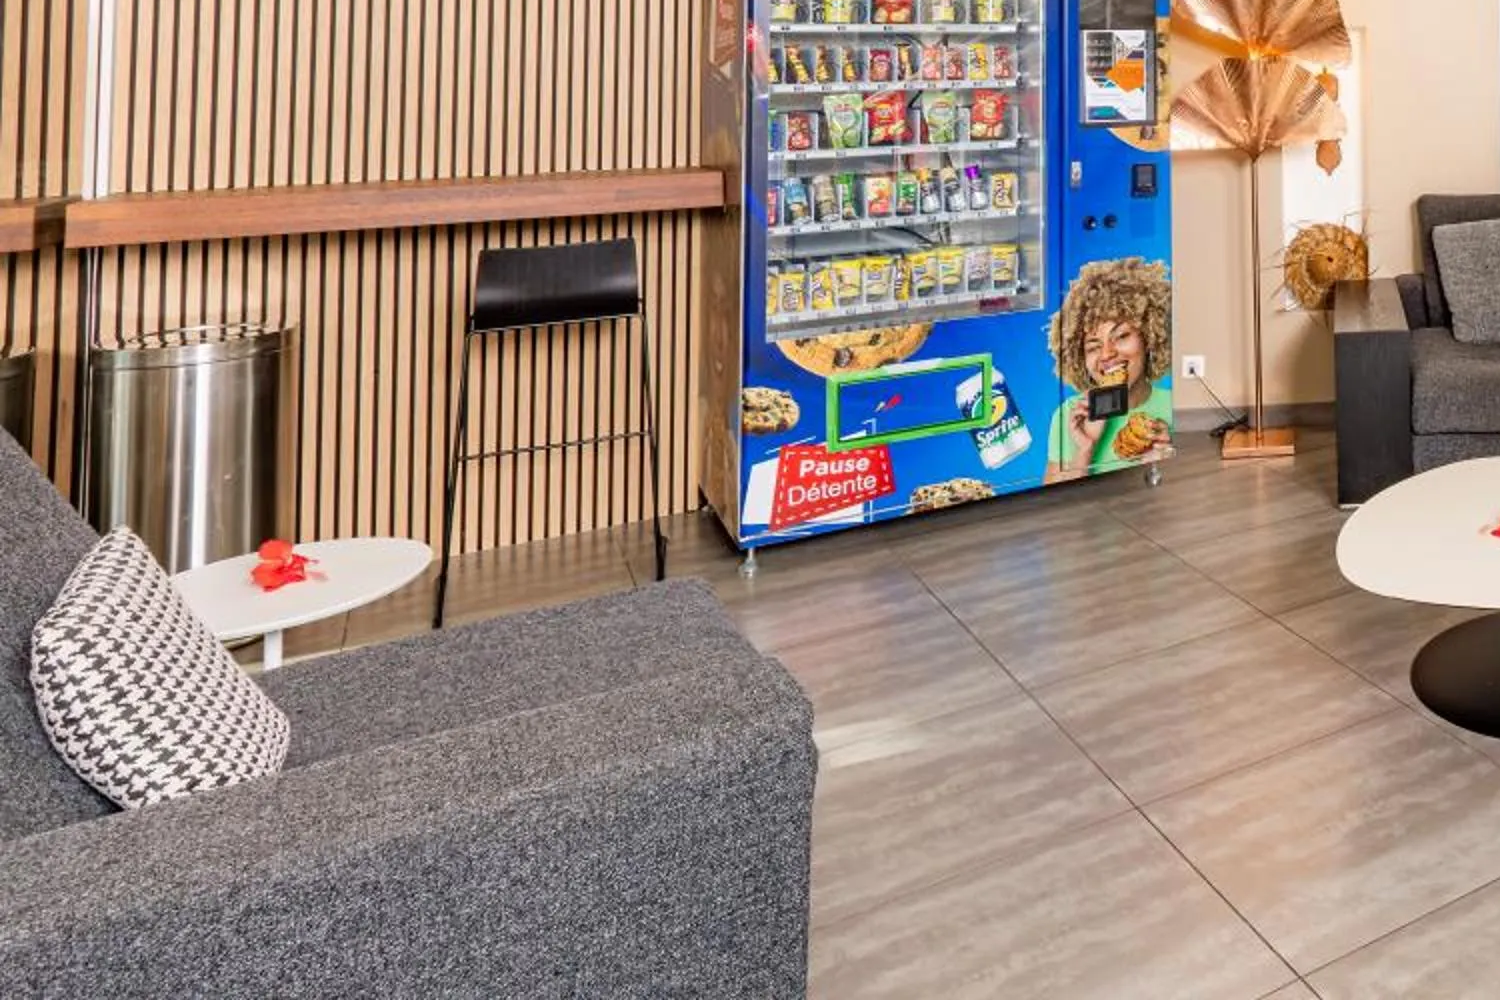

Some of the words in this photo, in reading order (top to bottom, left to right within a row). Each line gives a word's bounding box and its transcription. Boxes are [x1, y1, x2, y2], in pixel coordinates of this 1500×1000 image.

[975, 414, 1020, 449] Sprite
[799, 457, 870, 478] Pause
[788, 474, 878, 507] Détente
